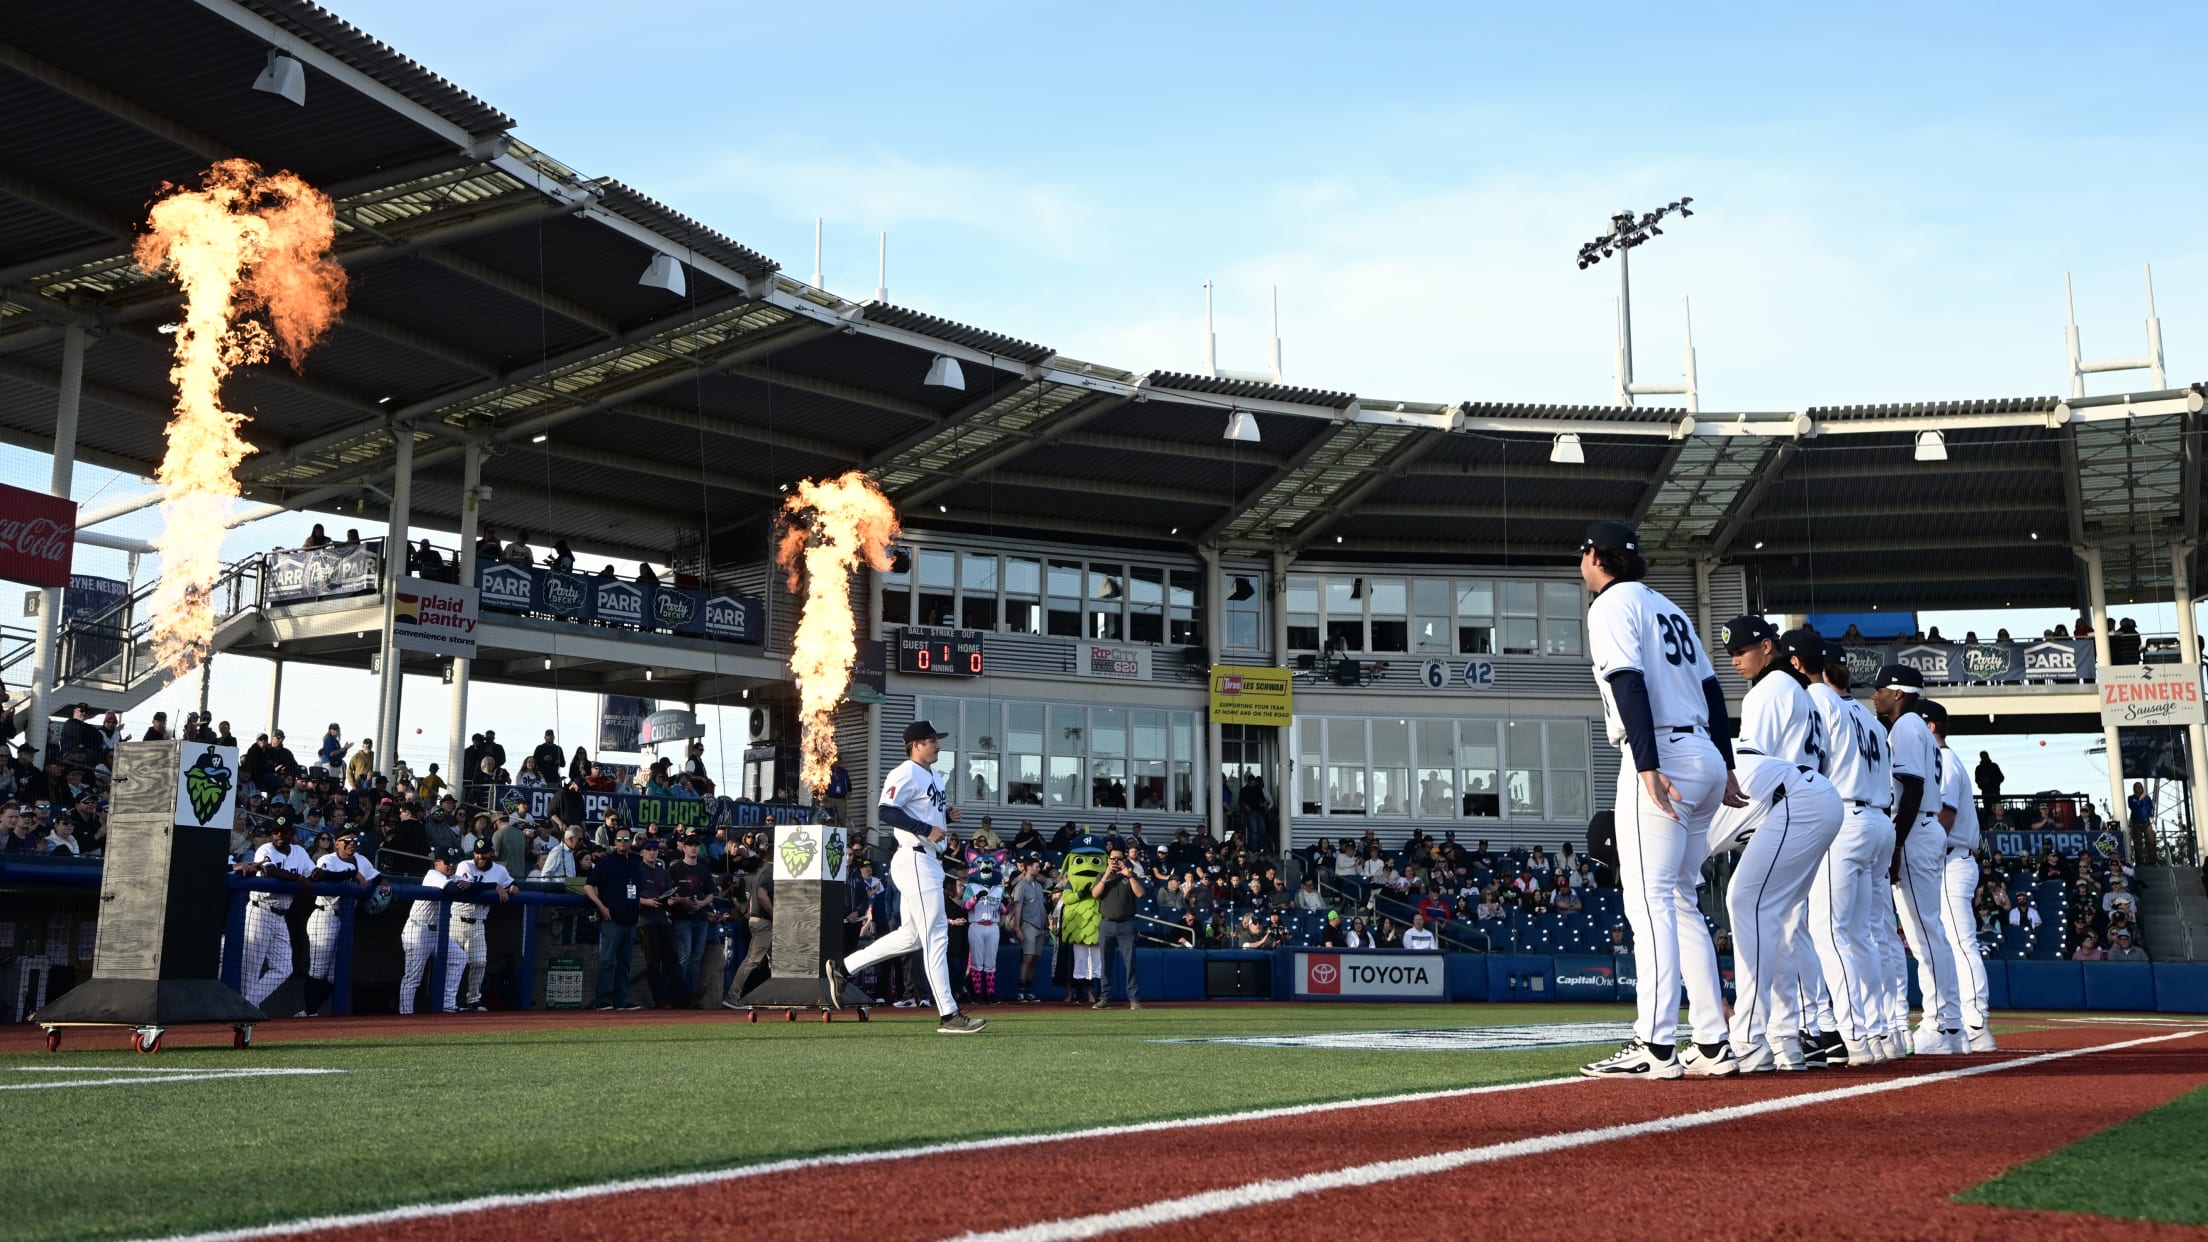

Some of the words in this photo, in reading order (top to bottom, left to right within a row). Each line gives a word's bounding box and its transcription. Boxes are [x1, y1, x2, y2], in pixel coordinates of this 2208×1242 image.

[342, 558, 376, 578] PARR
[69, 576, 96, 591] RYNE
[96, 579, 126, 597] NELSON
[481, 574, 531, 597] PARR
[546, 578, 580, 600] Party
[28, 598, 35, 612] 8
[420, 594, 464, 613] plaid
[597, 591, 642, 612] PARR
[657, 594, 689, 614] Party
[418, 611, 477, 633] pantry
[705, 605, 745, 627] PARR
[394, 627, 447, 642] convenience
[448, 636, 476, 646] stores
[908, 626, 925, 636] BALL
[930, 628, 955, 638] STRIKE
[961, 630, 975, 639] OUT
[1656, 613, 1697, 666] 38
[902, 639, 929, 650] GUEST
[957, 643, 981, 653] HOME
[374, 658, 380, 671] 8
[918, 650, 929, 669] 0
[943, 645, 949, 662] 1
[970, 653, 981, 672] 0
[930, 664, 955, 673] INNING
[1113, 661, 1137, 673] 620
[1846, 652, 1878, 668] Party
[1897, 656, 1948, 671] PARR
[1966, 649, 2003, 669] Party
[2024, 653, 2076, 669] PARR
[1428, 663, 1443, 687] 6
[1465, 662, 1492, 684] 42
[1223, 677, 1242, 690] Tires
[1243, 681, 1254, 690] LES
[1255, 682, 1284, 691] SCHWAB
[2104, 681, 2197, 704] ZENNER'S
[2124, 702, 2177, 721] Sausage
[651, 723, 677, 741] CIDER
[531, 791, 555, 817] GO
[638, 799, 660, 824] GO
[738, 804, 760, 826] GO
[1996, 833, 2022, 856] GO
[1348, 965, 1429, 985] TOYOTA
